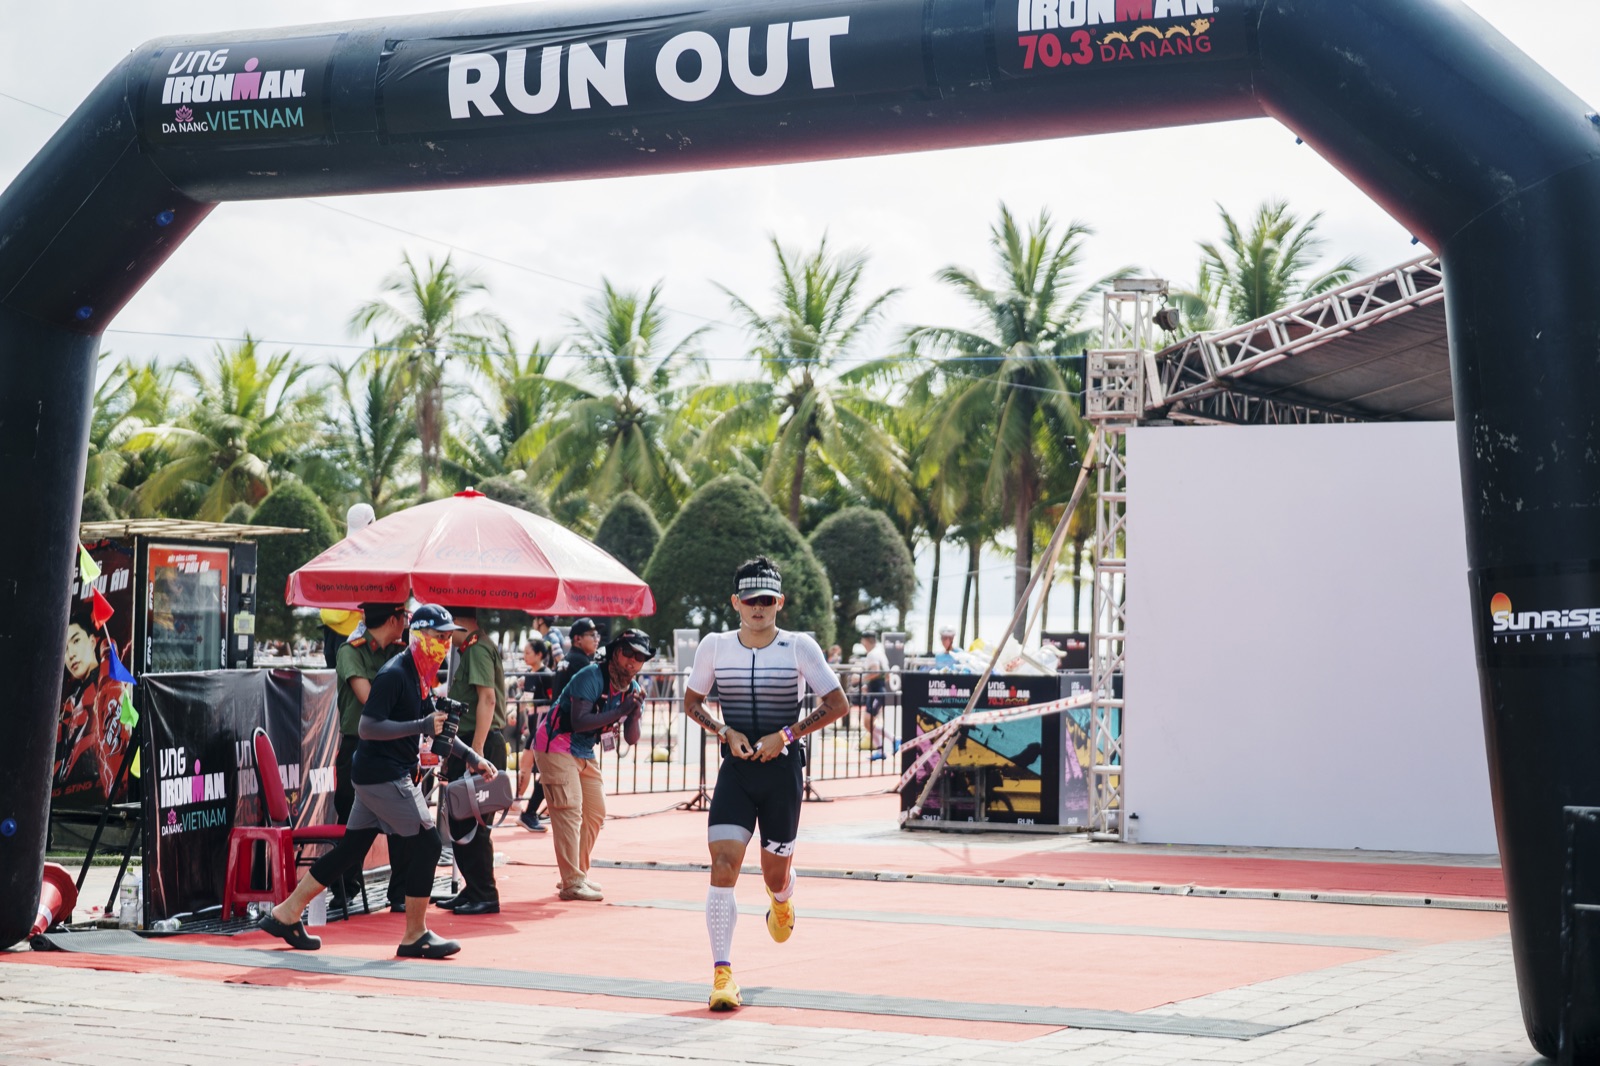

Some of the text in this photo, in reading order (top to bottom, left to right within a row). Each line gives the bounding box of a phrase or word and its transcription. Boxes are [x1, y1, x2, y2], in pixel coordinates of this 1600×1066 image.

[1018, 0, 1213, 32] IRONMAN
[168, 49, 229, 75] VNG
[1018, 30, 1212, 69] 70.3 DA NANG
[162, 58, 305, 104] IRONMAN
[448, 16, 850, 119] RUN OUT
[162, 107, 304, 133] DA NANG VIETNAM
[428, 586, 454, 595] Ngon
[457, 587, 486, 597] không
[928, 684, 970, 697] IRONMAN
[987, 685, 1030, 698] IRONMAN
[159, 747, 186, 777] VNG
[161, 759, 226, 808] IRONMAN
[181, 807, 227, 832] VIETNAM
